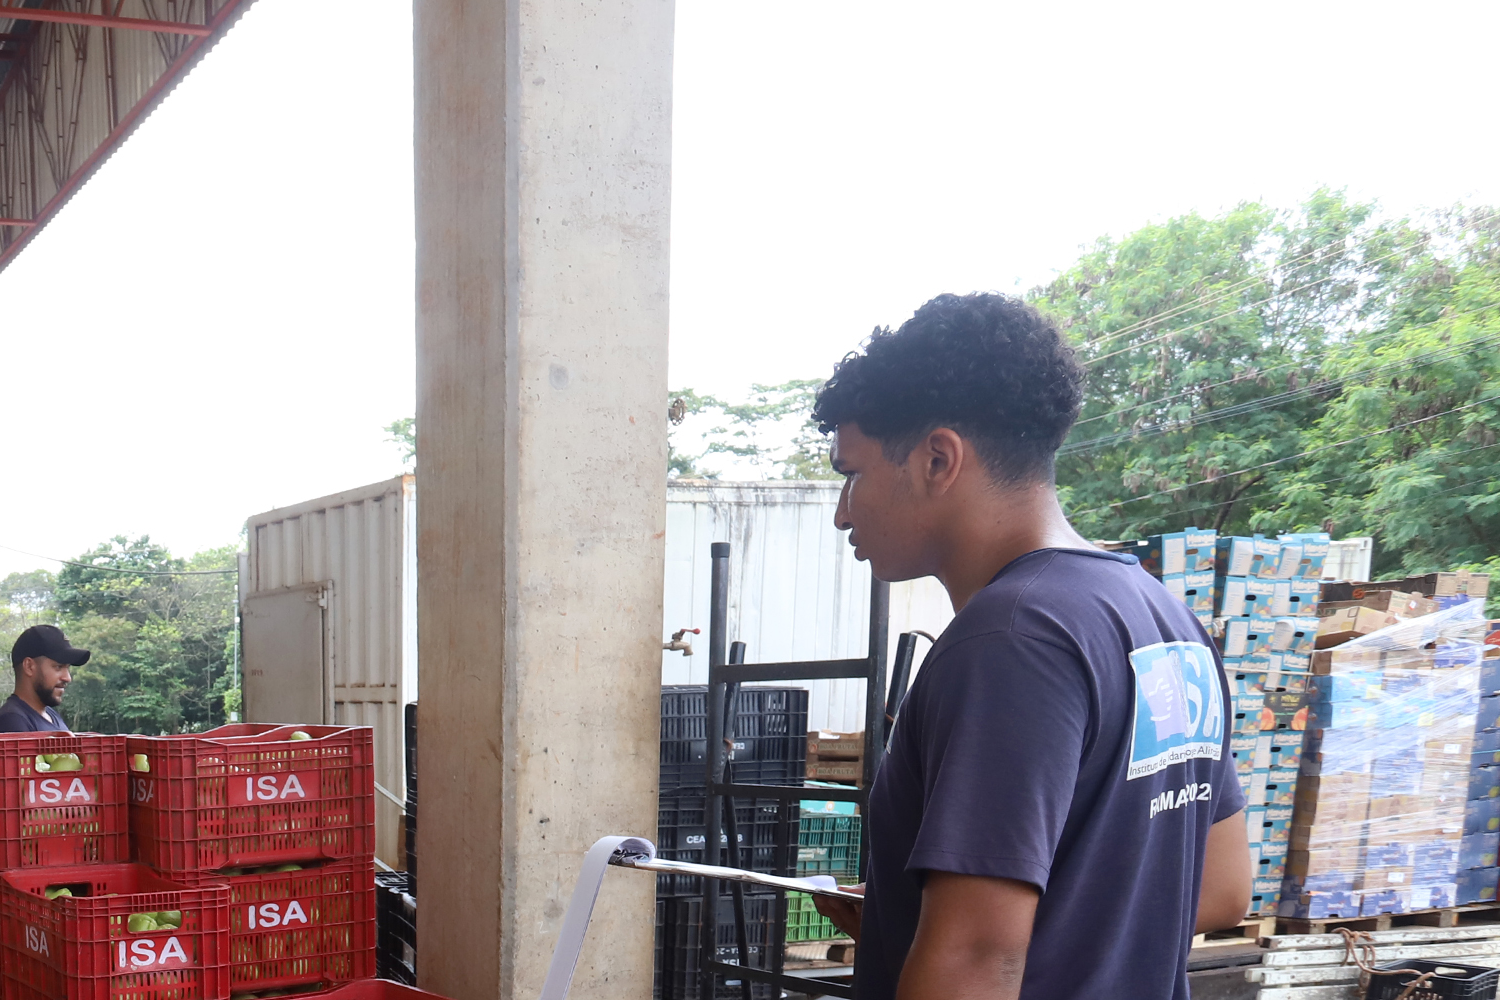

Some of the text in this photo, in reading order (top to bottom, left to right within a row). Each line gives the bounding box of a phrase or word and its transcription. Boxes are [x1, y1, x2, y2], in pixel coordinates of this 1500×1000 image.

[1130, 762, 1158, 776] Institut
[28, 778, 91, 803] ISA
[246, 774, 305, 801] ISA
[248, 900, 308, 930] ISA
[25, 924, 50, 958] ISA
[118, 936, 188, 968] ISA
